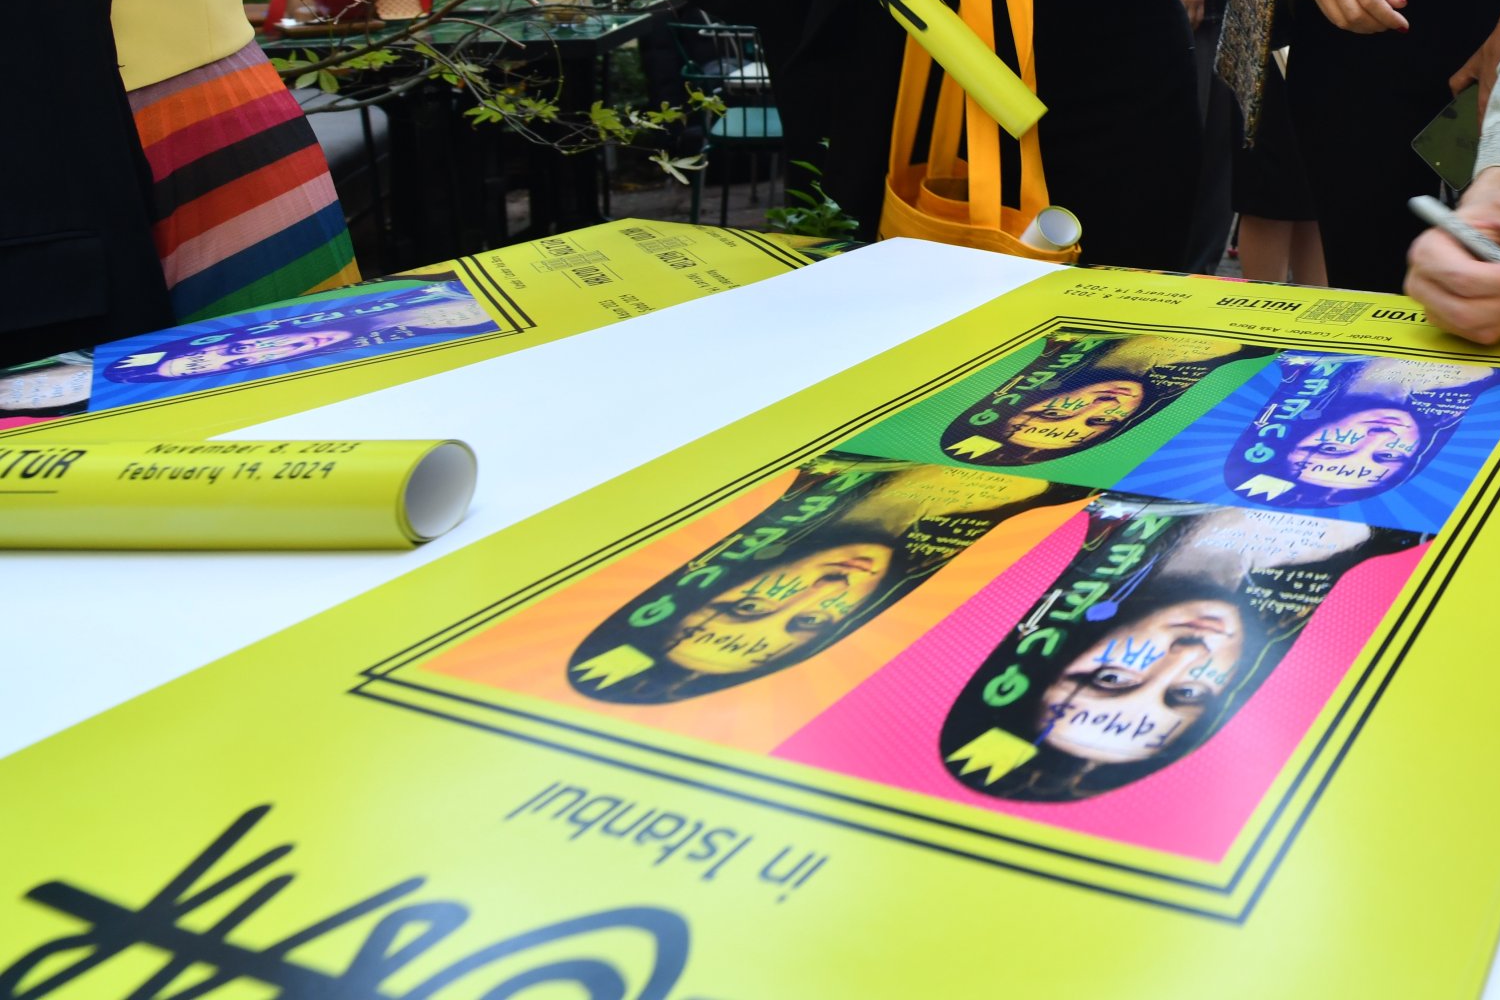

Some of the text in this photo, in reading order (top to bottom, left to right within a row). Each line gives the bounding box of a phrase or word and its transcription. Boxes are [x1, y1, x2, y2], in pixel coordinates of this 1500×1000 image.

[1216, 296, 1302, 312] KÜLTÜR
[969, 338, 1101, 425] QUEEN
[1043, 396, 1090, 412] ART
[1243, 360, 1340, 464] QUEEN
[146, 443, 265, 454] November
[1314, 428, 1364, 446] ART
[0, 447, 87, 479] TÜR
[118, 461, 226, 485] February
[273, 461, 337, 479] 2024
[627, 470, 872, 629] QUEEN
[739, 573, 810, 600] ART
[983, 514, 1172, 707] QUEEN
[1094, 636, 1165, 671] ART
[504, 781, 828, 904] in Istanbul
